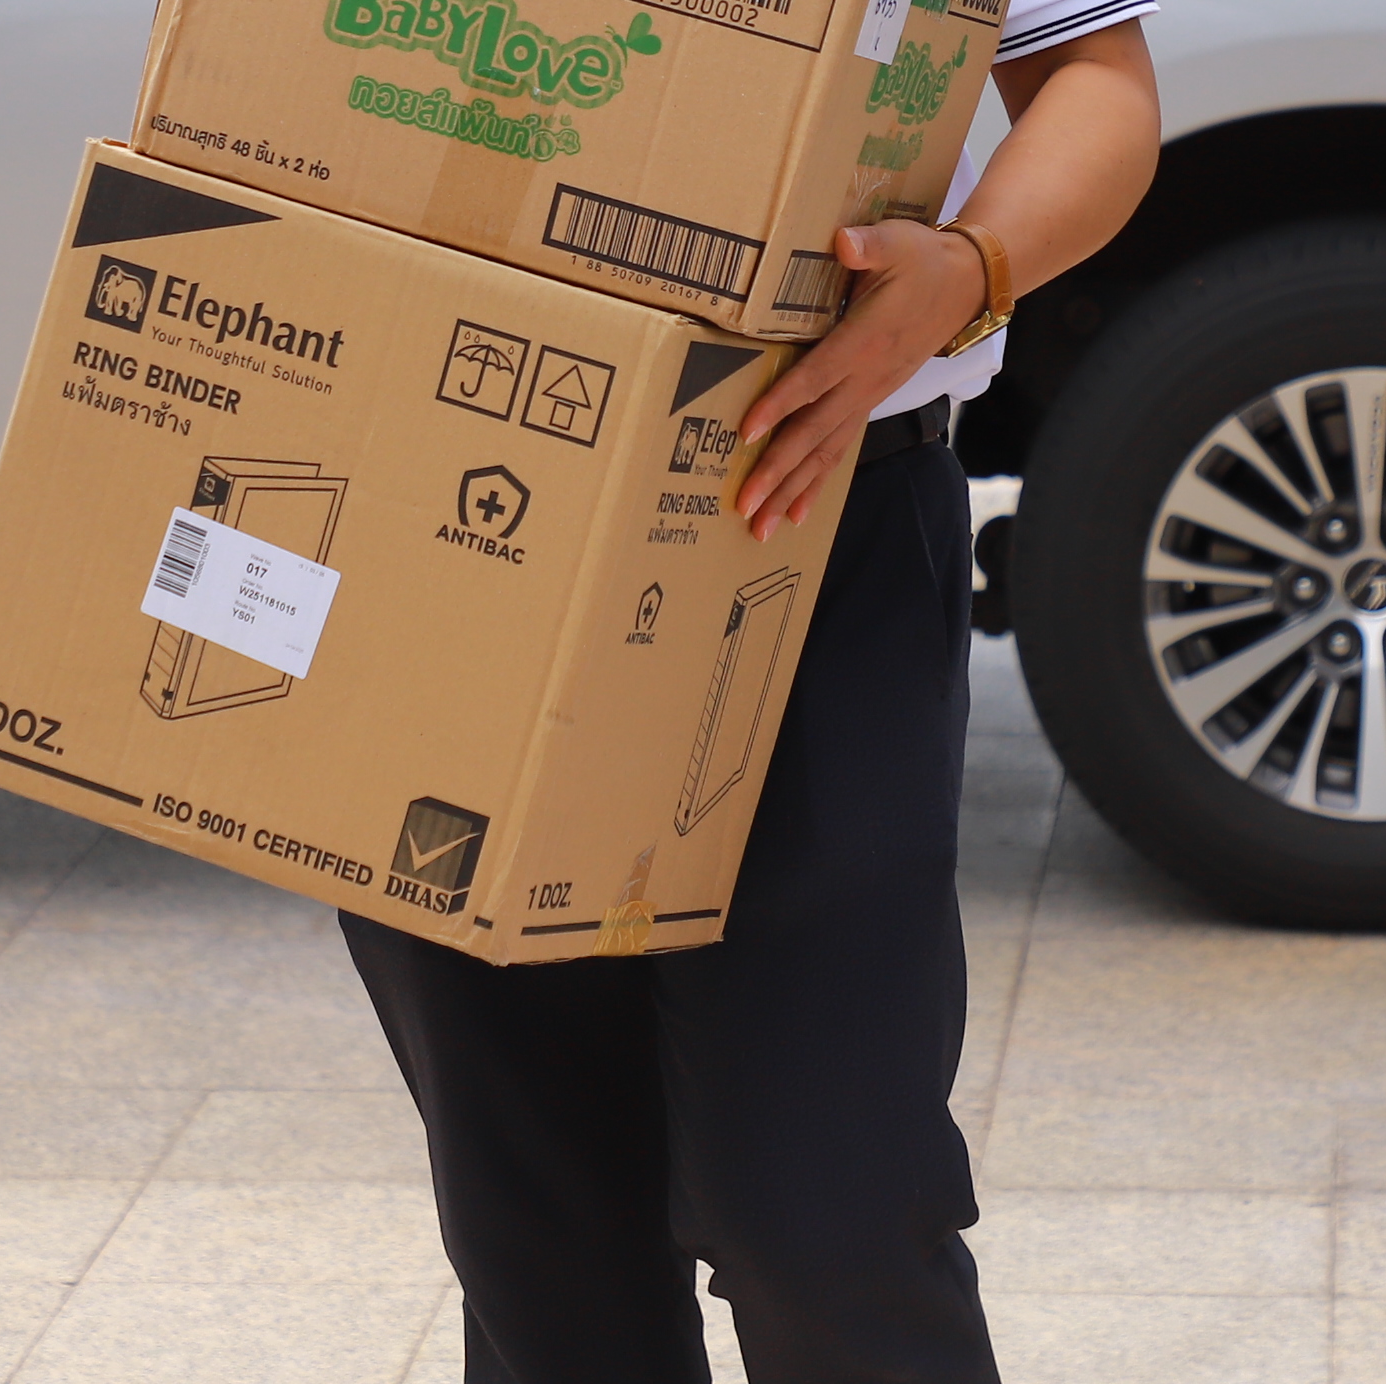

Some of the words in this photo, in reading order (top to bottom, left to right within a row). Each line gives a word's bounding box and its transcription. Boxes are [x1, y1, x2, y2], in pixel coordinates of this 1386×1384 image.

[231, 139, 251, 157] 48
[255, 140, 275, 165] ชิ้น
[278, 156, 289, 169] x
[293, 158, 304, 173] 2
[308, 160, 330, 181] ห่อ
[586, 260, 602, 273] 88
[611, 266, 652, 287] 50709
[660, 281, 702, 302] 20167
[158, 275, 345, 368] Elephant
[73, 341, 138, 381] RING
[144, 364, 242, 415] BINDER
[151, 326, 182, 348] Your
[188, 338, 266, 374] Thoughtful
[271, 365, 333, 395] Solution
[62, 375, 192, 436] แฟ้มตราช้าง
[700, 419, 738, 463] Elep
[657, 492, 683, 514] RING
[435, 524, 526, 565] ANTIBAC
[246, 562, 268, 579] 017
[232, 608, 256, 625] YS01
[239, 585, 297, 616] W251181015
[625, 632, 655, 644] ANTIBAC
[153, 793, 193, 824] ISO
[196, 808, 246, 843] 9001
[253, 829, 374, 887] CERTIFIED
[384, 875, 451, 915] DHAS
[528, 886, 537, 910] 1
[538, 882, 573, 910] DOZ.
